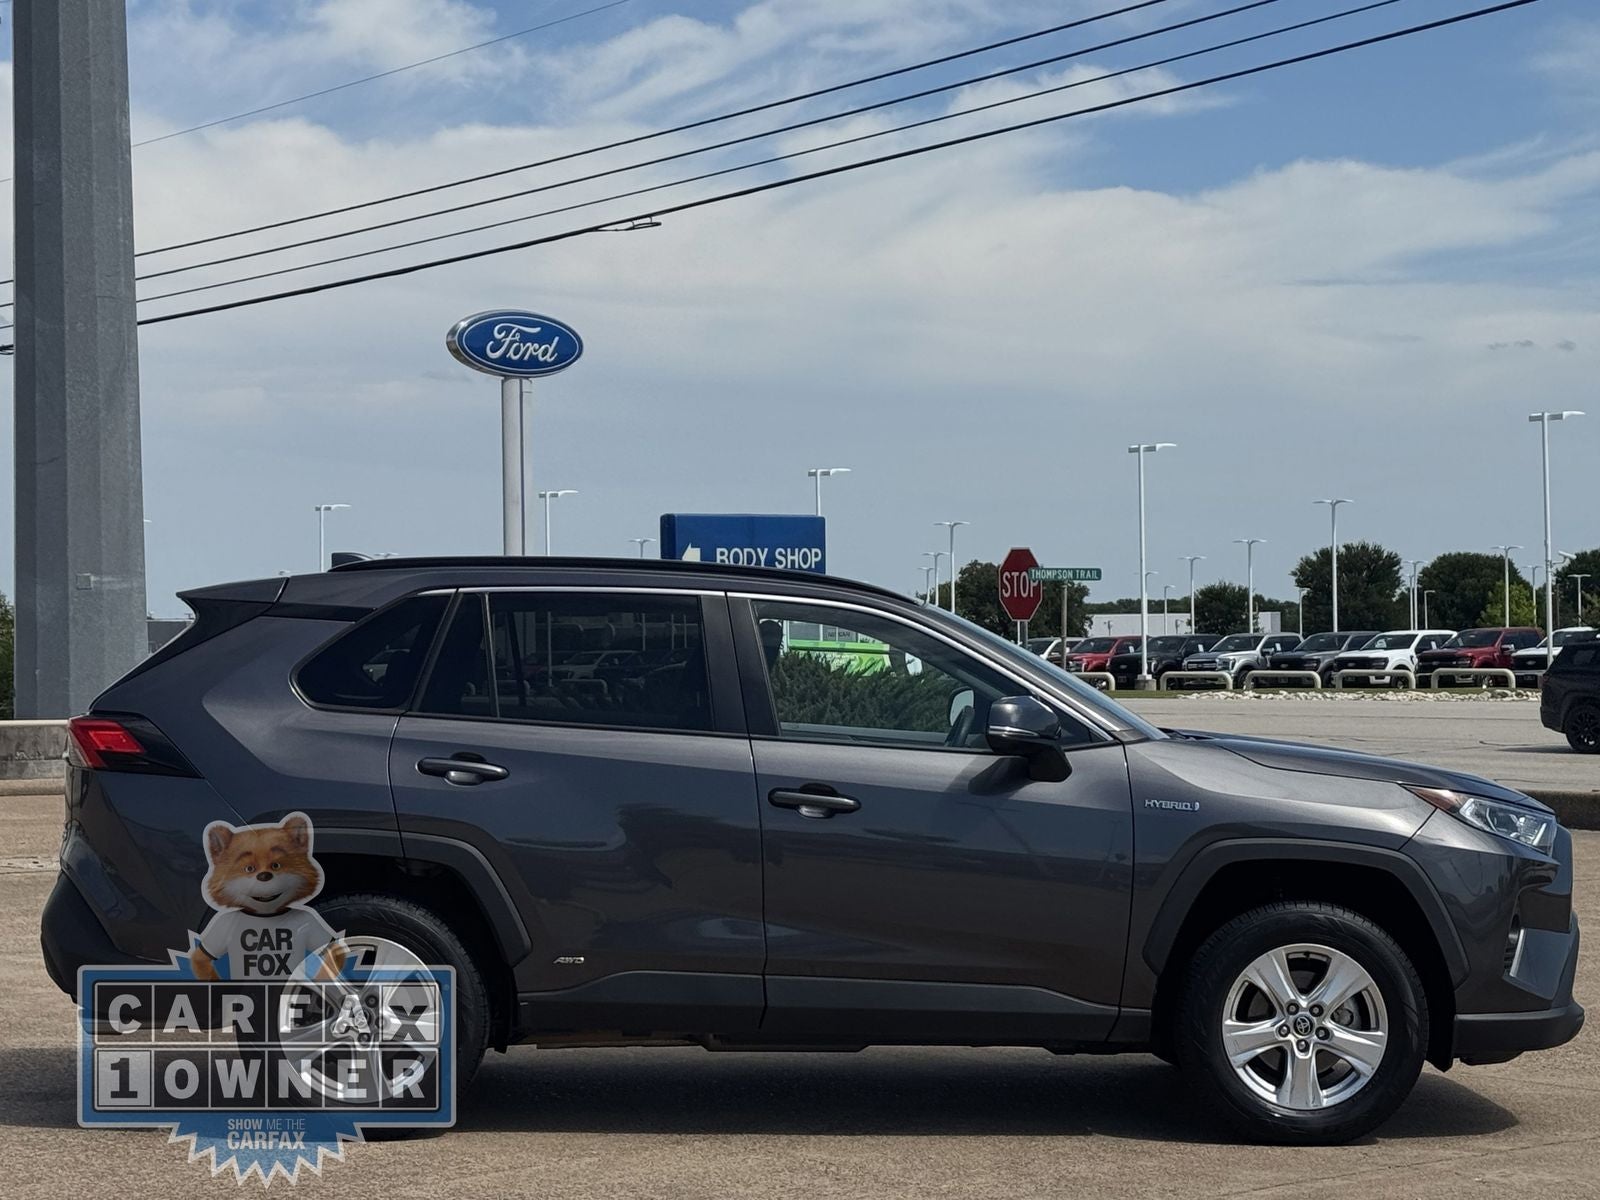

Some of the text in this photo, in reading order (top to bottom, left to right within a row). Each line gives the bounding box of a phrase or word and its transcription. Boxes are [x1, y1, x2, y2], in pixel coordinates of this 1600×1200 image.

[486, 323, 560, 362] Ford
[716, 547, 822, 569] BODY SHOP
[1002, 571, 1039, 598] STOP
[1031, 569, 1098, 579] THOMPSON TRAIL
[1144, 799, 1193, 811] HYBRID
